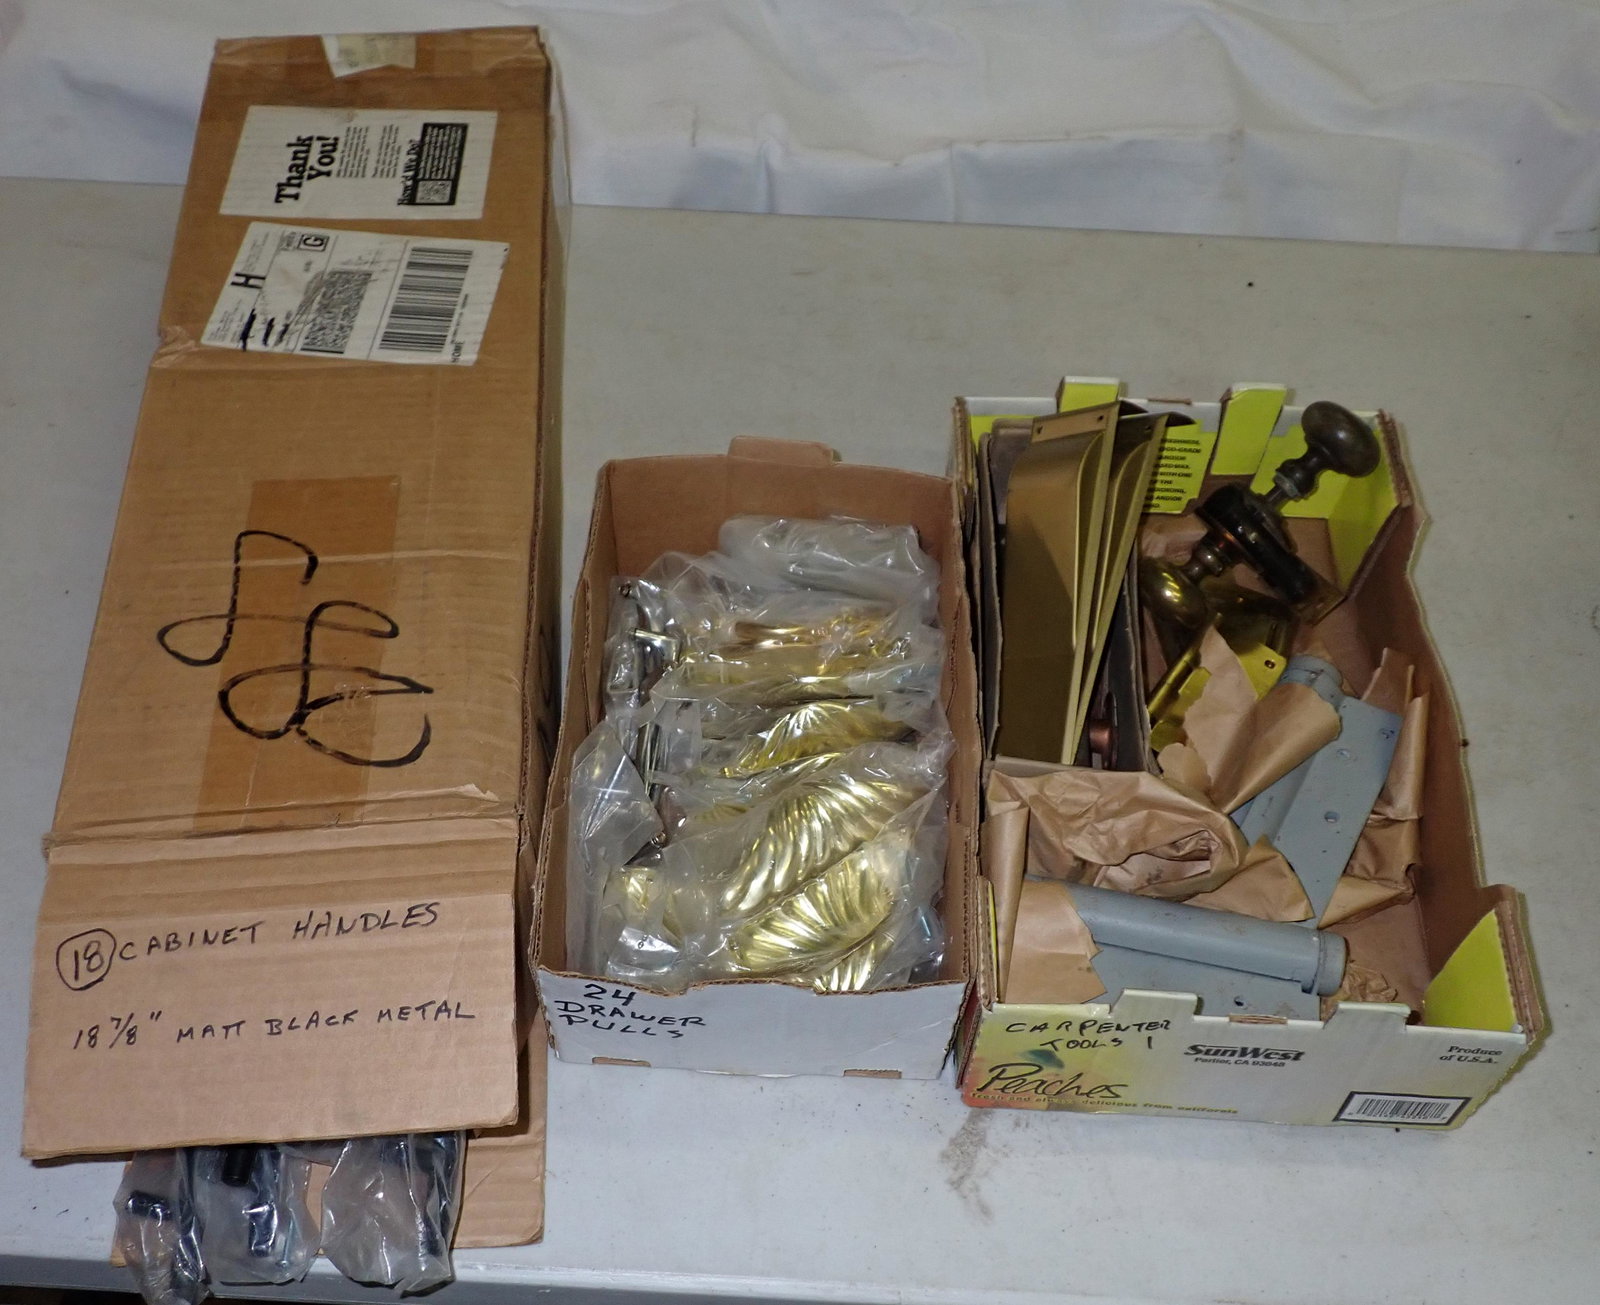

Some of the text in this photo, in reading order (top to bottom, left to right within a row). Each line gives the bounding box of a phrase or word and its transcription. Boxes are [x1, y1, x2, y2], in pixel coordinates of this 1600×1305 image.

[307, 136, 340, 181] You!
[274, 135, 314, 204] Thank
[302, 235, 326, 249] G
[230, 272, 266, 290] H
[72, 902, 441, 981] 18 CABINET HANDLES
[583, 984, 637, 1006] 24
[554, 1000, 707, 1027] DRAWER
[73, 1024, 98, 1051] 18
[176, 1019, 246, 1044] MATT
[264, 1009, 360, 1037] BLACK
[376, 1001, 476, 1024] METAL
[558, 1014, 684, 1039] PULLS
[1005, 1019, 1171, 1036] CARPENTER
[1040, 1037, 1124, 1052] TOOLS
[1184, 1043, 1306, 1061] SunWest
[1447, 1045, 1503, 1056] Produce
[1456, 1055, 1499, 1064] U.S.A.
[976, 1062, 1129, 1099] Peaches
[971, 1092, 1004, 1100] fresh
[1081, 1099, 1138, 1108] delicious
